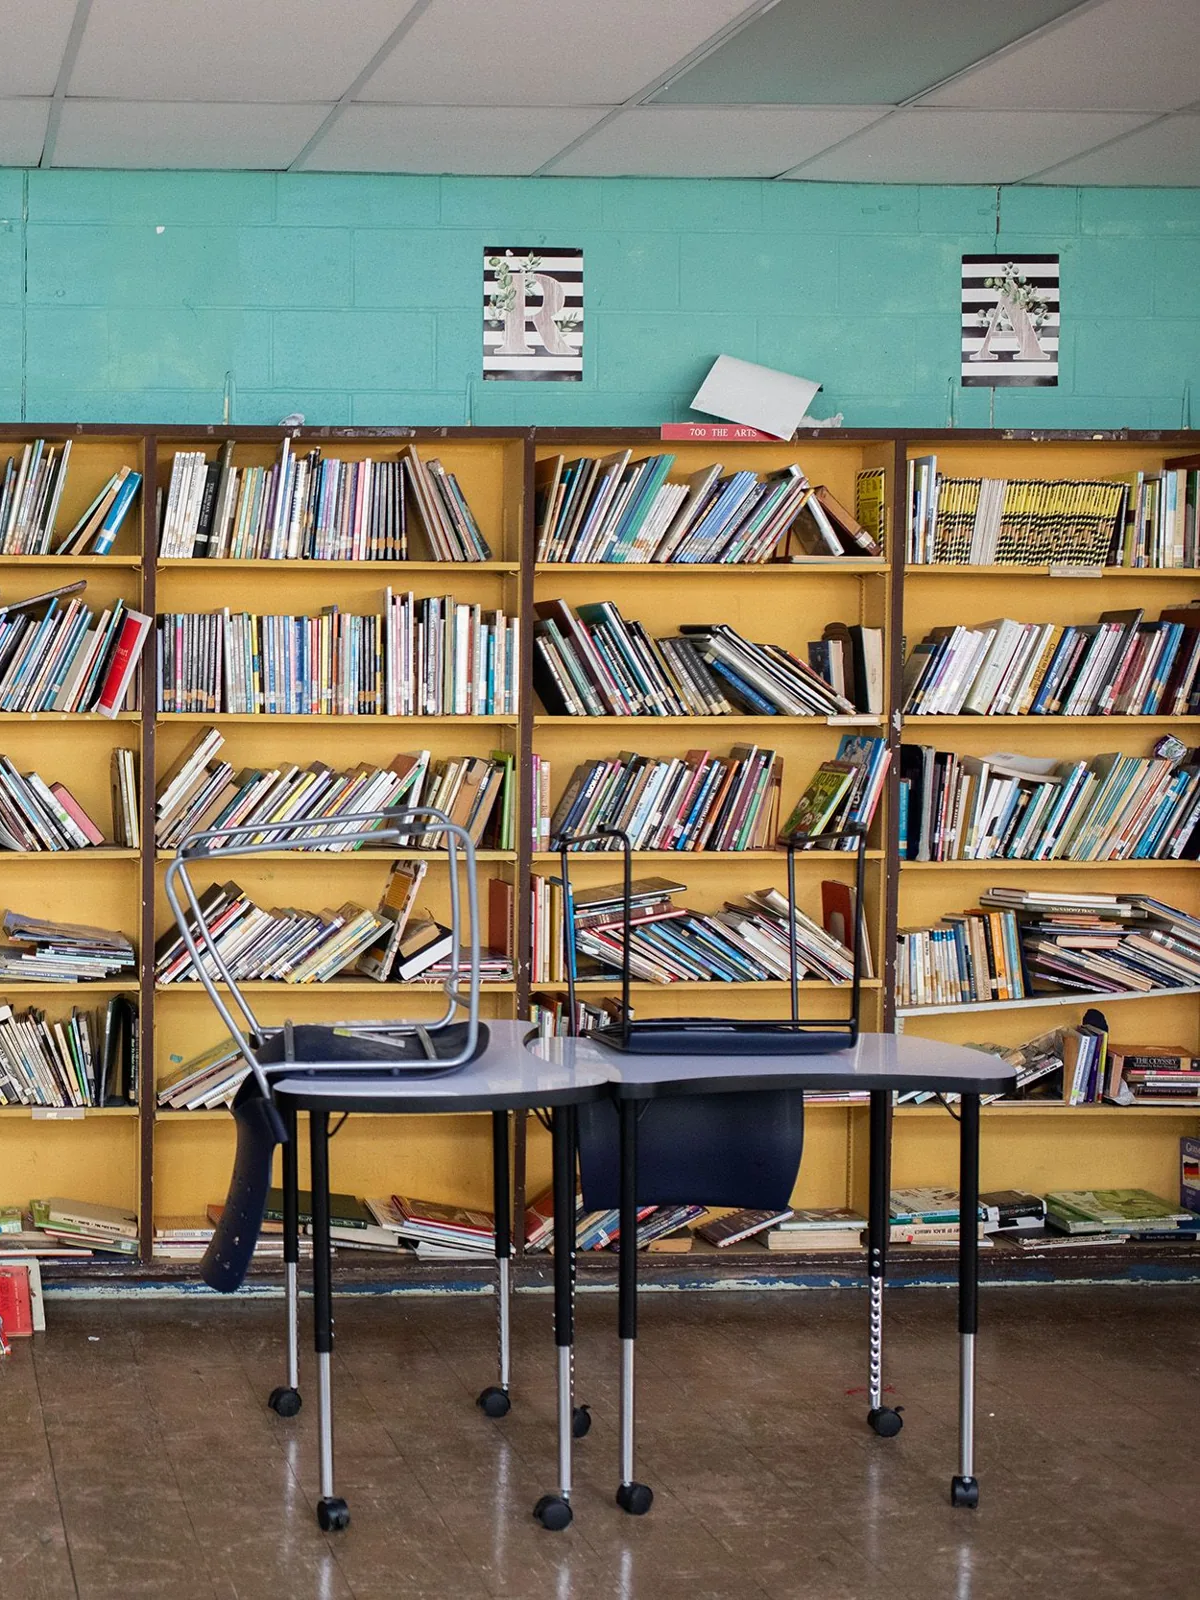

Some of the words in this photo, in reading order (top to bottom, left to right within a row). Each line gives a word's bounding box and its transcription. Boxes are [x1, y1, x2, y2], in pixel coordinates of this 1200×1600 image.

[494, 272, 579, 355] R
[969, 277, 1050, 360] A
[690, 428, 706, 437] 700
[712, 428, 728, 437] THE
[734, 428, 757, 437] ARTS
